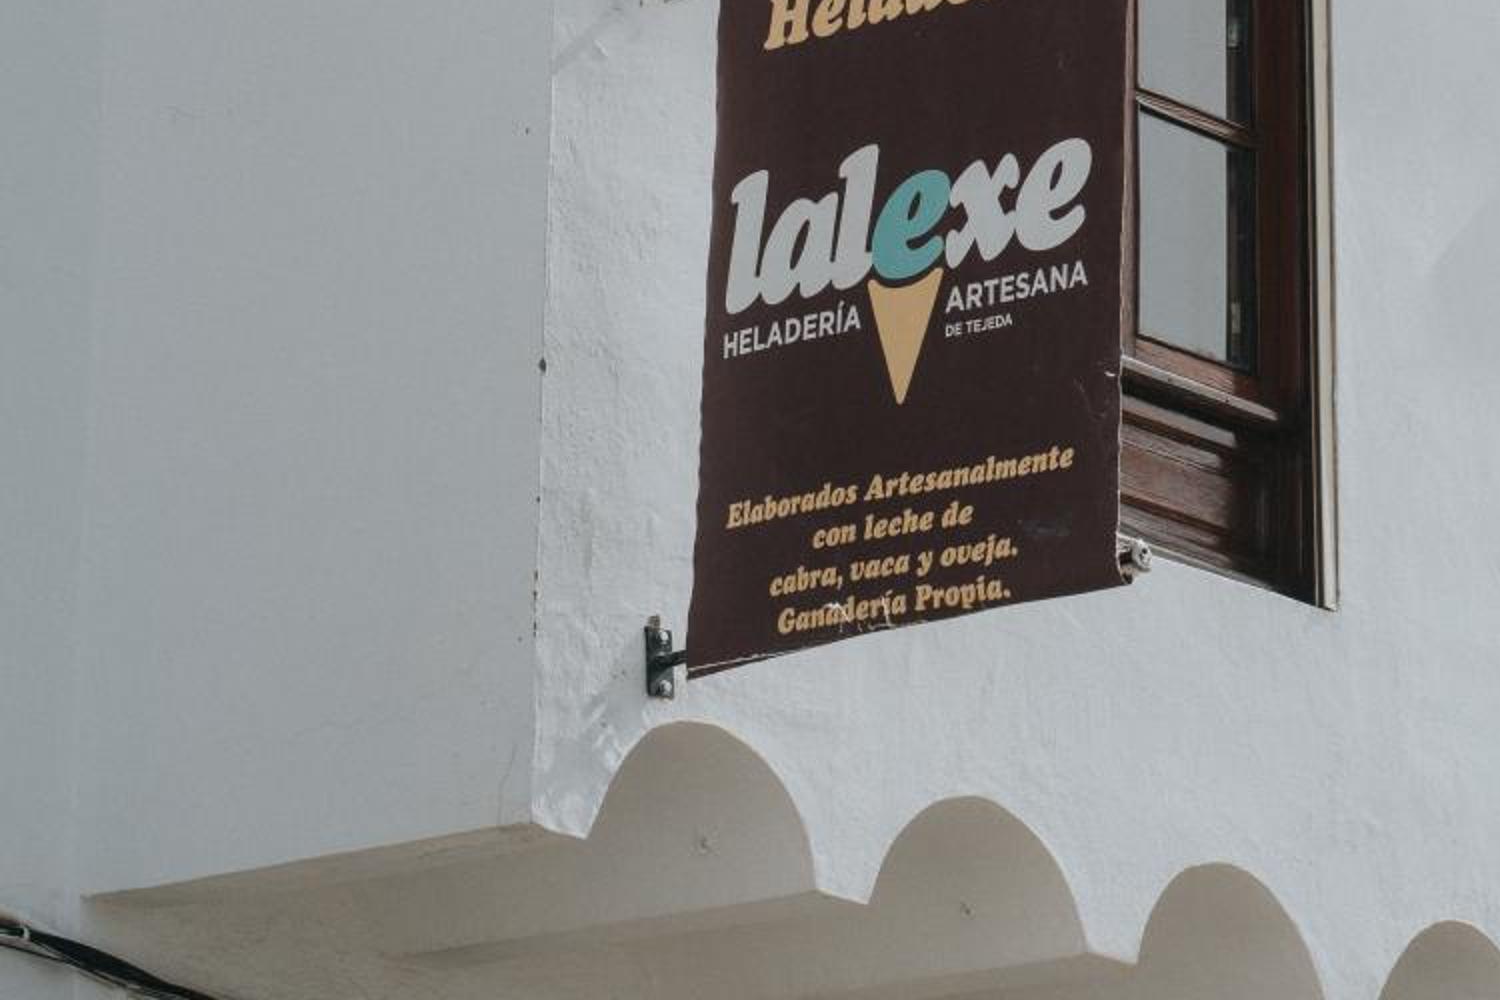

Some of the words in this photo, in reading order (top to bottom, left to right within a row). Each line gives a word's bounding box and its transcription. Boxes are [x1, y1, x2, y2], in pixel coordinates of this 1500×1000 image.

[726, 137, 1094, 315] lalexe
[945, 260, 1089, 314] ARTESANA
[722, 301, 862, 360] HELADERÍA
[945, 322, 963, 338] DE
[966, 313, 1014, 336] TEJEDA
[725, 483, 858, 530] Elaborados
[864, 444, 1076, 502] Artesanalmente
[812, 524, 856, 550] con
[863, 512, 934, 544] leche
[941, 502, 974, 526] de
[769, 566, 844, 597] cabra,
[850, 554, 910, 581] vaca
[917, 548, 935, 576] y
[940, 534, 1019, 569] oveja.
[777, 590, 907, 635] Ganadería
[914, 575, 1012, 611] Propia.
